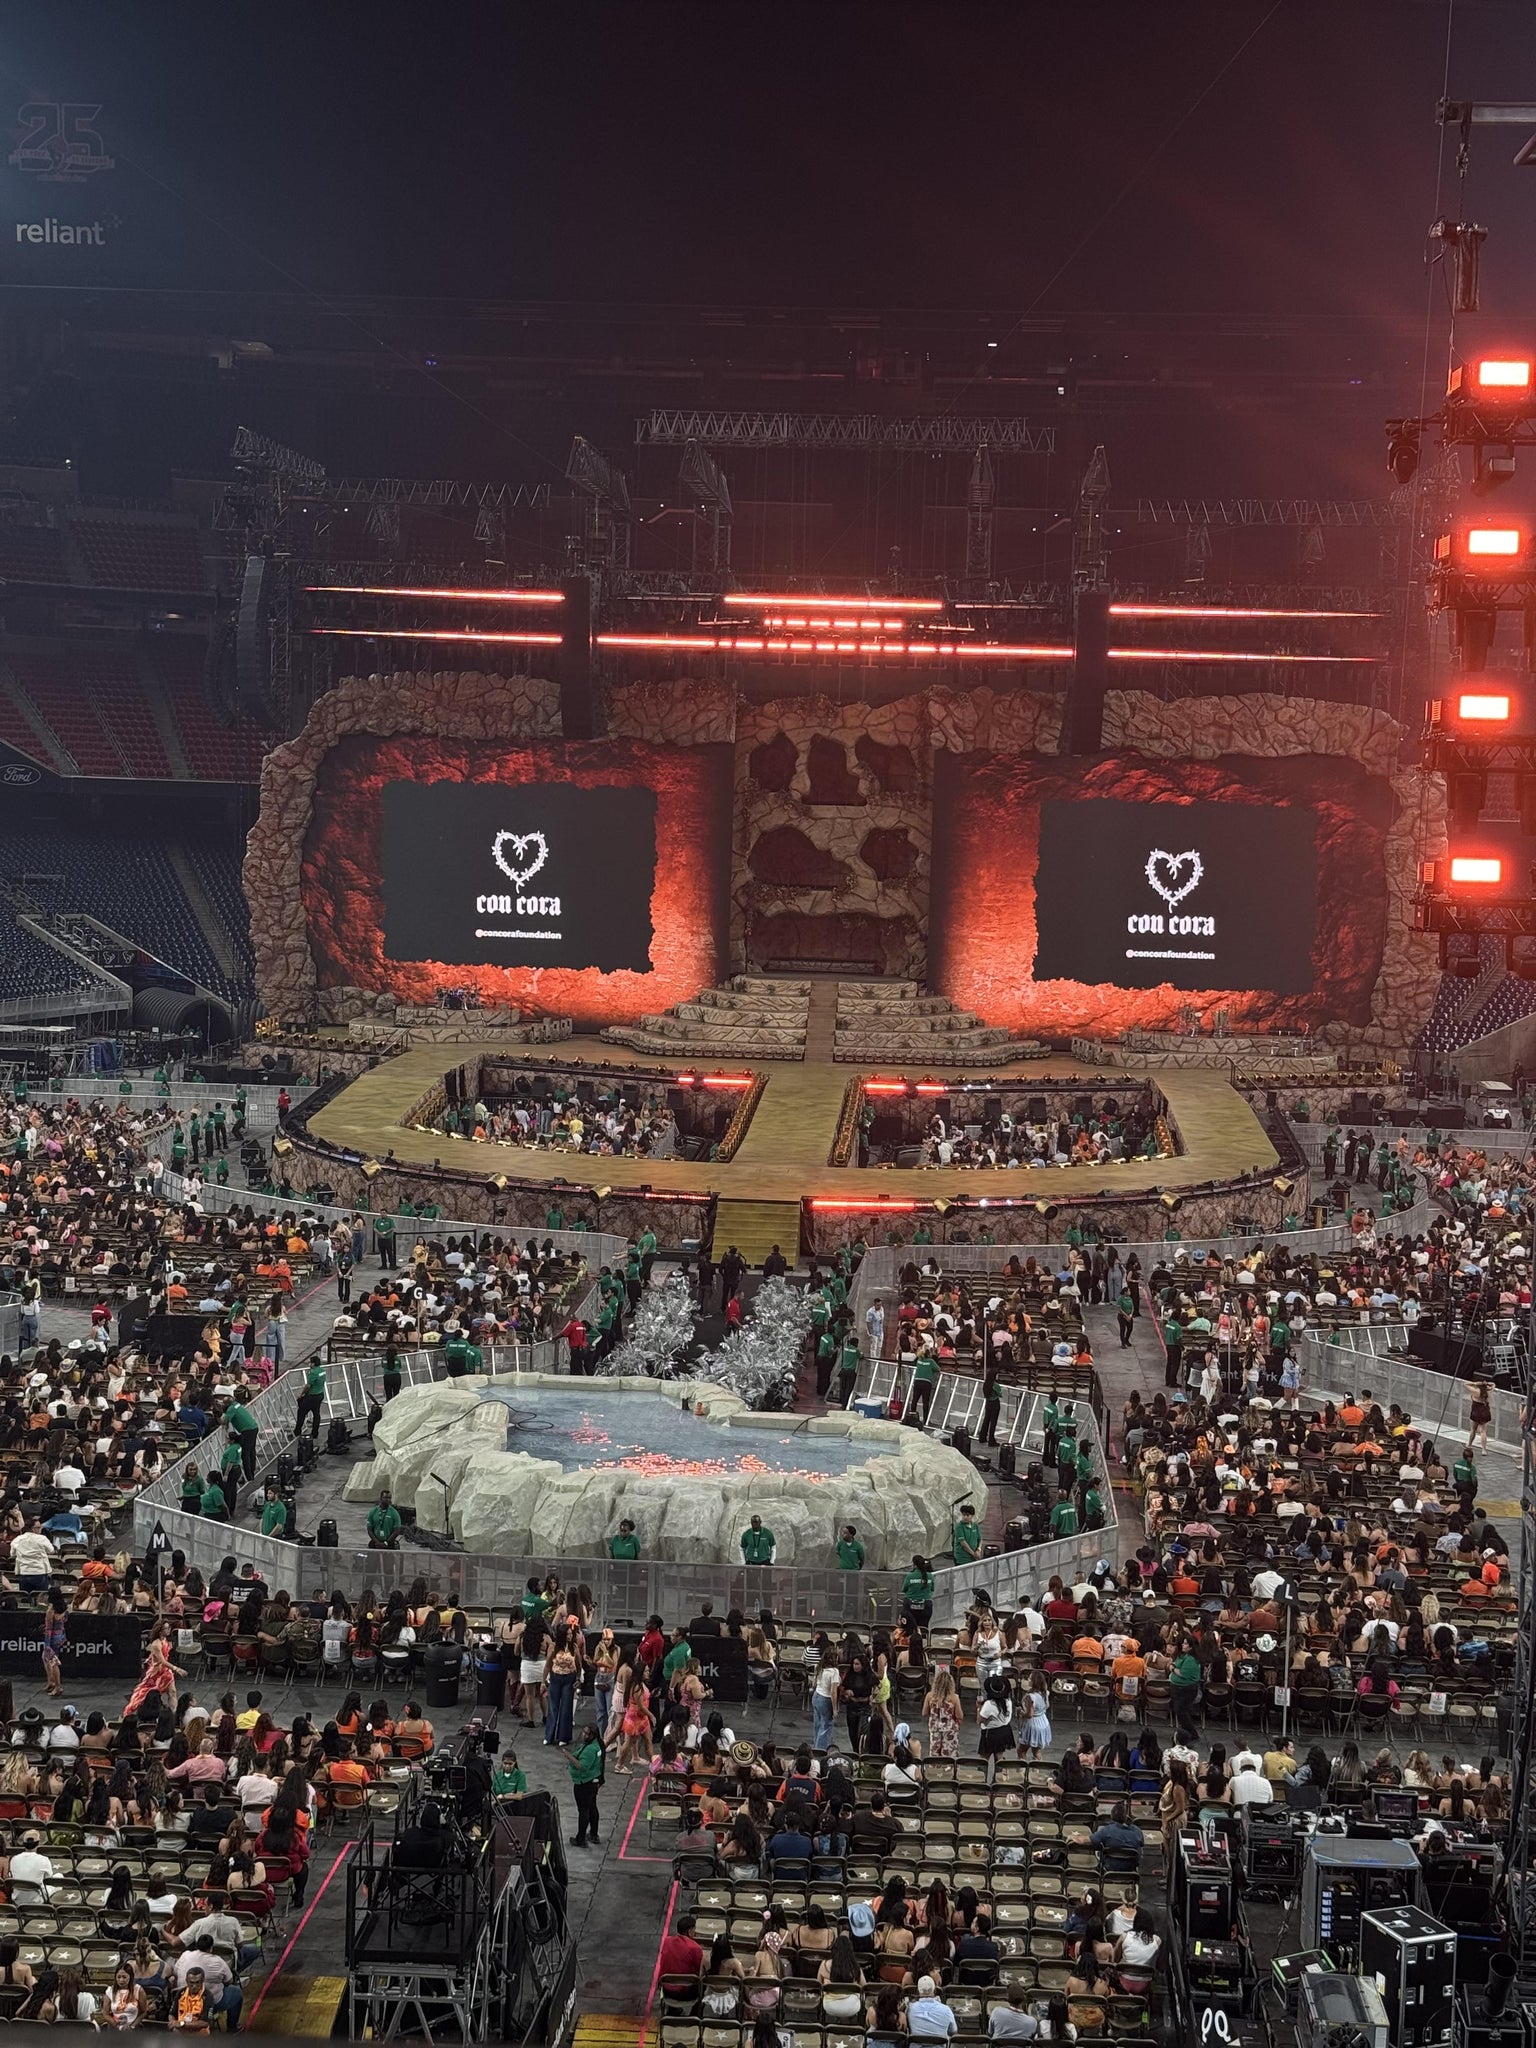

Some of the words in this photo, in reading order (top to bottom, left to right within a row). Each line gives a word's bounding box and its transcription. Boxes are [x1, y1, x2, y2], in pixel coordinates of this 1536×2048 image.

[18, 102, 104, 172] 25
[16, 218, 106, 246] reliant
[3, 766, 32, 783] Ford
[476, 894, 512, 914] con
[516, 896, 562, 916] cora
[1127, 914, 1164, 934] con
[1168, 915, 1215, 936] cora
[475, 929, 562, 940] @concorafoundation
[1126, 949, 1215, 960] @concorafoundation
[165, 1259, 174, 1272] H
[413, 1287, 423, 1300] G
[153, 1533, 165, 1549] M
[1284, 1583, 1293, 1600] L
[1, 1637, 46, 1652] relian
[75, 1639, 113, 1657] park
[697, 1662, 720, 1677] ark
